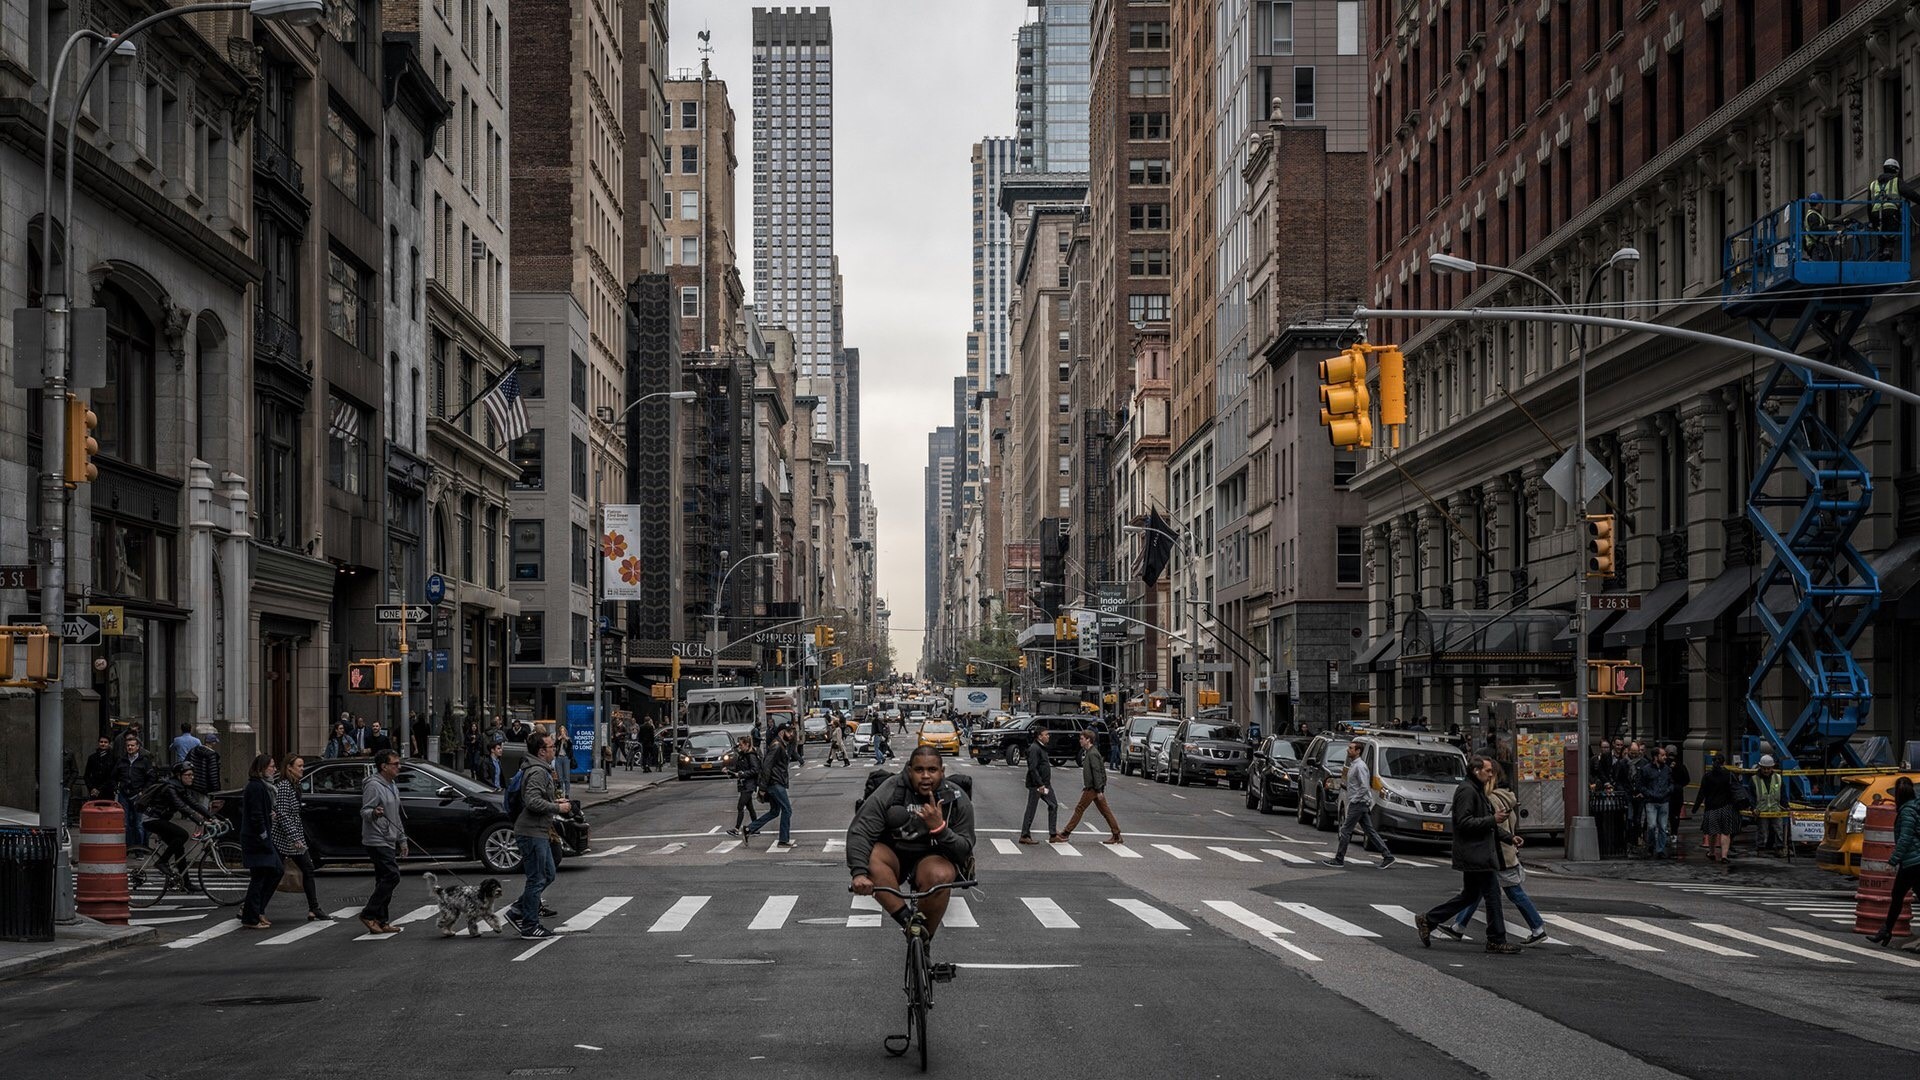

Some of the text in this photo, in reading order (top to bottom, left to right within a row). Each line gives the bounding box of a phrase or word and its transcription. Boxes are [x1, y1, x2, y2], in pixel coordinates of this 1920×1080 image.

[12, 571, 24, 587] St
[1599, 600, 1629, 608] E 26 St
[62, 624, 88, 635] WAY
[672, 642, 712, 657] SICIS
